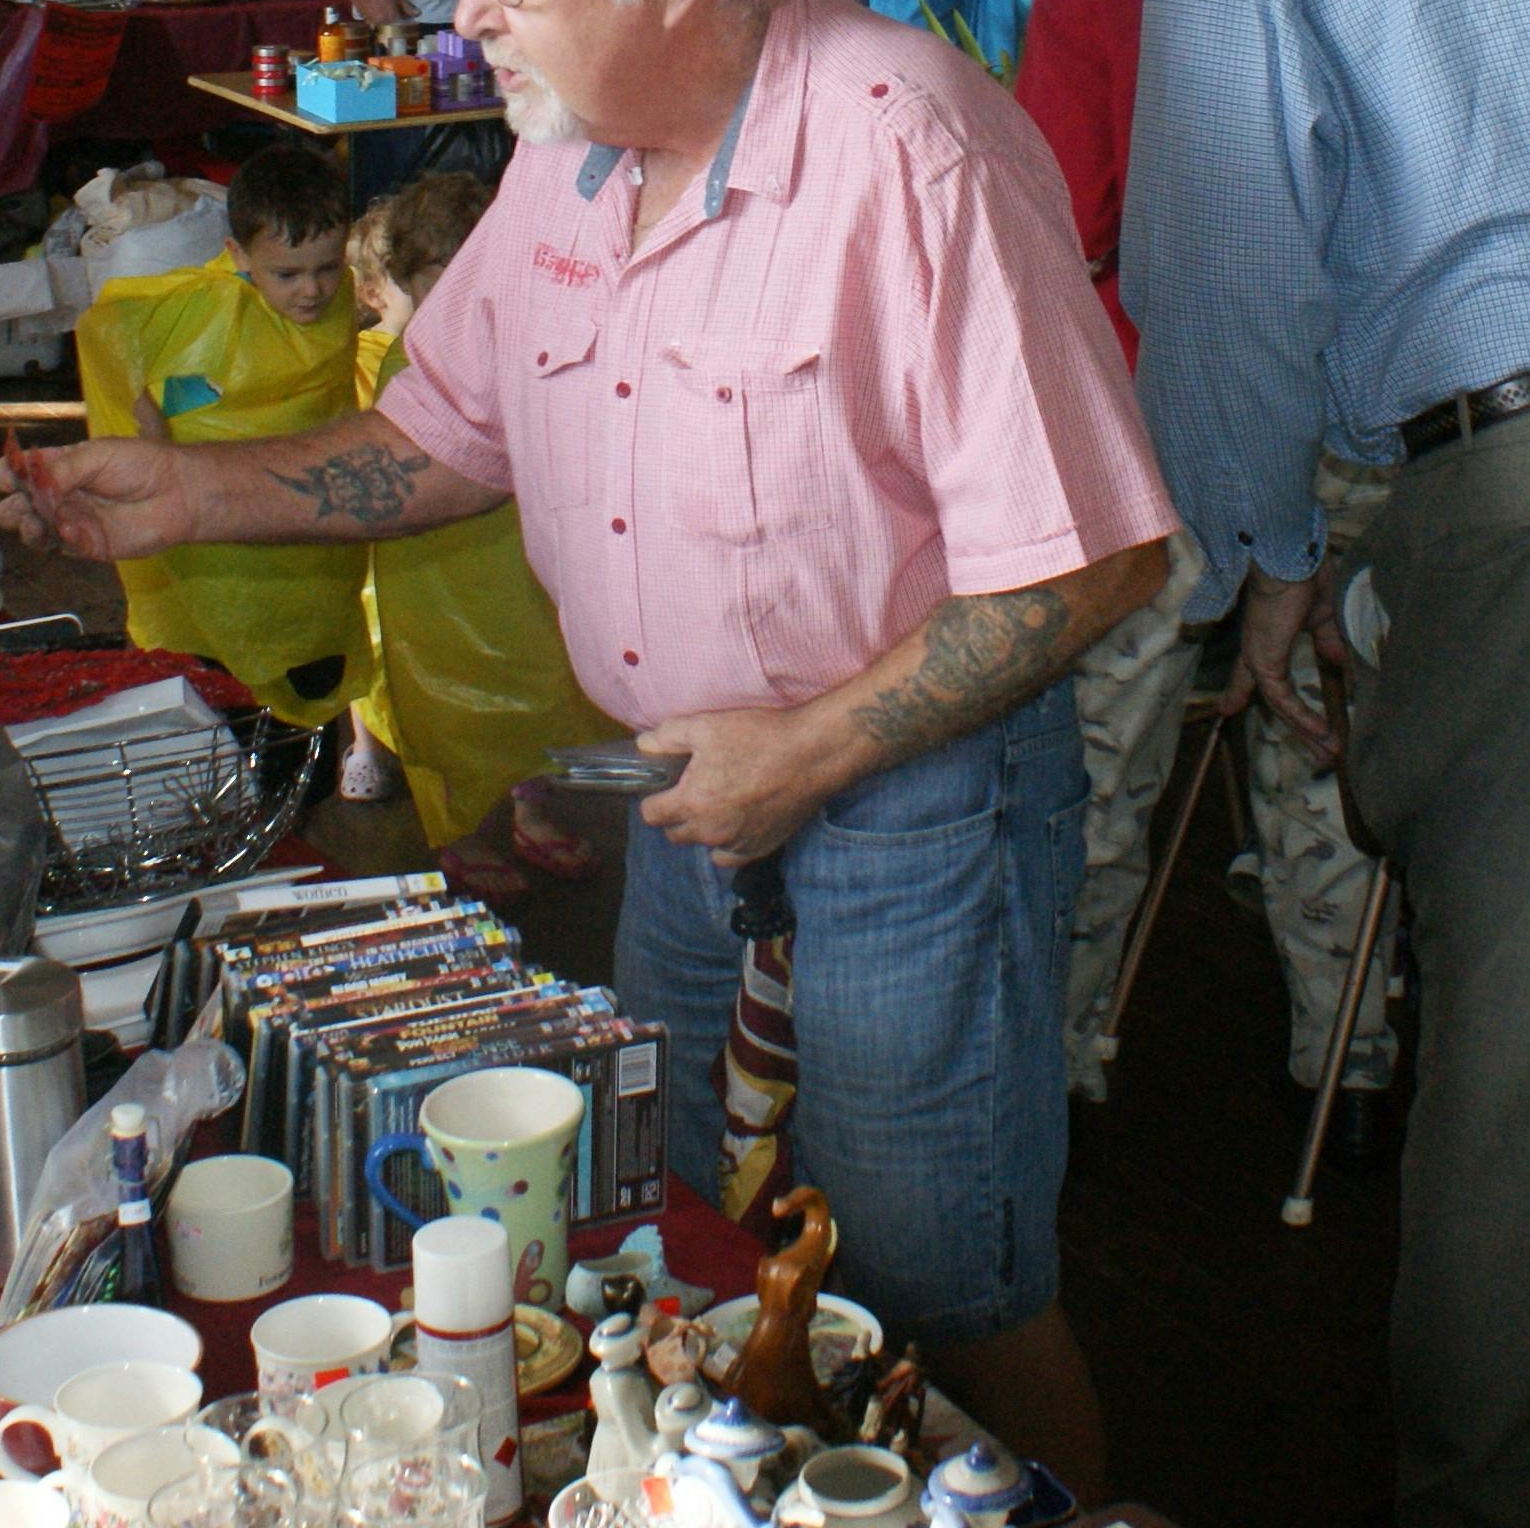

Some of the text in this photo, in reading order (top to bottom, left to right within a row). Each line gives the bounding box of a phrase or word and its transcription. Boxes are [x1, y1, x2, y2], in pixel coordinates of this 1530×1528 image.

[292, 886, 348, 901] women
[235, 950, 303, 970] STEPHEN
[349, 938, 455, 970] HEATHCLIFF
[356, 989, 464, 1018] STARDUST
